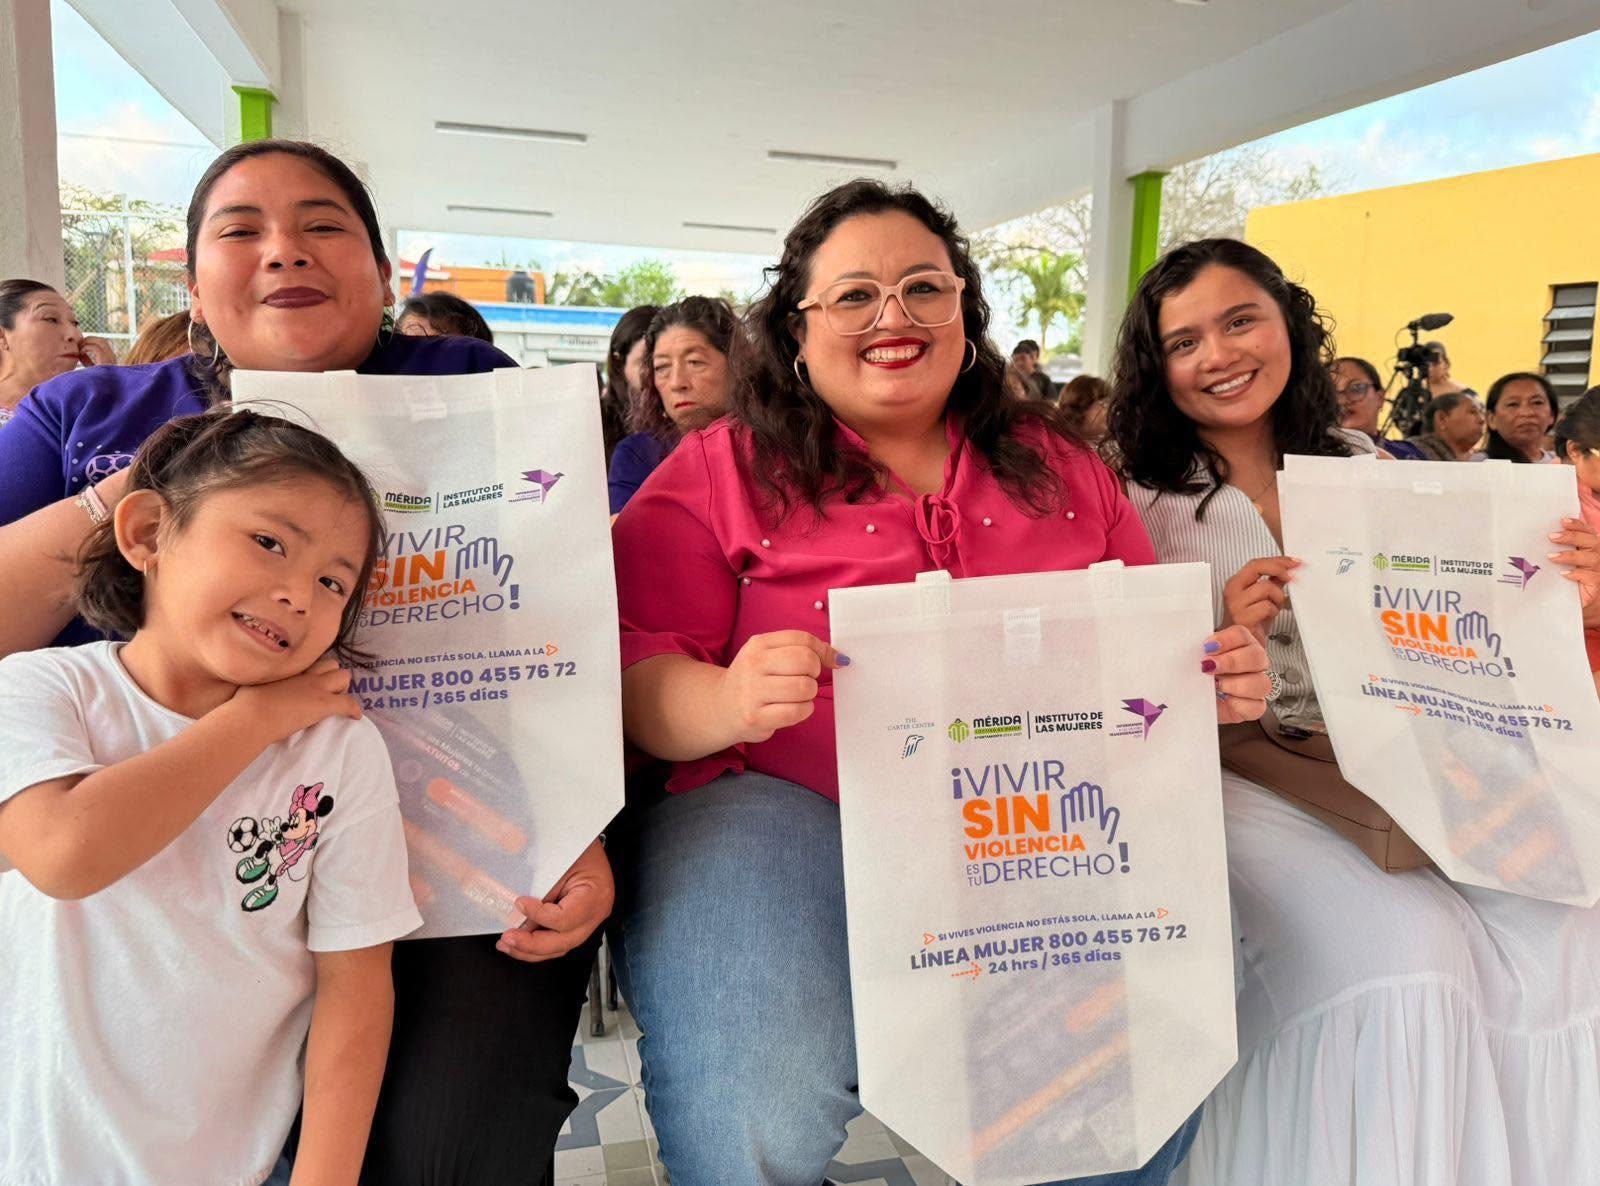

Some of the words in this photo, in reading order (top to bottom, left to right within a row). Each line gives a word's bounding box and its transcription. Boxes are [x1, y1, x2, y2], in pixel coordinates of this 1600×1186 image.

[385, 491, 431, 504] MÉRIDA
[443, 486, 490, 500] INSTITUTO
[492, 483, 504, 491] DE
[443, 499, 460, 509] LAS
[461, 491, 503, 507] MUJERES
[380, 525, 466, 556] VIVIR
[367, 550, 446, 591] SIN
[1440, 559, 1482, 568] INSTITUTO
[1440, 566, 1456, 574] LAS
[1457, 567, 1493, 577] MUJERES
[370, 584, 520, 627] DERECHO!
[1373, 584, 1461, 614] ¡VIVIR
[1380, 610, 1449, 643] SIN
[407, 656, 422, 665] NO
[424, 652, 456, 663] ESTÁS
[488, 649, 522, 659] LLAMA
[524, 648, 531, 656] A
[532, 647, 545, 655] LA
[1387, 635, 1478, 659] VIOLENCIA
[1405, 649, 1516, 678] DERECHO!
[348, 673, 425, 694] MUJER
[431, 669, 474, 688] 800
[479, 666, 521, 684] 455
[525, 664, 549, 680] 76
[553, 661, 577, 677] 72
[363, 696, 385, 710] 24
[389, 696, 418, 708] hrs
[422, 690, 429, 709] /
[433, 690, 466, 705] 365
[469, 688, 509, 702] días
[1361, 682, 1410, 702] LÍNEA
[1410, 692, 1467, 714] MUJER
[1466, 706, 1495, 722] 800
[1498, 714, 1530, 728] 455
[1531, 716, 1552, 729] 76
[1553, 719, 1573, 731] 72
[911, 722, 935, 730] CENTER
[973, 715, 1022, 729] MÉRIDA
[1035, 712, 1088, 724] INSTITUTO
[1090, 711, 1104, 721] DE
[1035, 723, 1055, 733] LAS
[1056, 720, 1103, 732] MUJERES
[1425, 707, 1443, 719] 24
[1444, 711, 1465, 723] hrs
[1472, 718, 1494, 732] 365
[1495, 726, 1523, 739] días
[951, 759, 1066, 800] ¡VIVIR
[962, 793, 1051, 839] SIN
[964, 834, 1086, 861] VIOLENCIA
[966, 864, 980, 876] ES
[983, 842, 1131, 885] DERECHO!
[967, 875, 982, 887] TU
[938, 933, 947, 942] SI
[948, 929, 975, 941] VIVES
[976, 921, 1025, 936] VIOLENCIA
[1026, 919, 1041, 928] NO
[1041, 915, 1071, 926] ESTÁS
[1071, 914, 1100, 924] SOLA,
[1101, 912, 1134, 922] LLAMA
[1135, 911, 1143, 920] A
[1143, 911, 1156, 919] LA
[910, 948, 971, 970] LÍNEA
[974, 936, 1045, 960] MUJER
[1048, 931, 1088, 950] 800
[1092, 928, 1134, 945] 455
[1137, 927, 1161, 943] 76
[1164, 924, 1188, 940] 72
[988, 962, 1009, 975] 24
[1011, 957, 1039, 972] hrs
[1041, 953, 1049, 970] /
[1051, 952, 1082, 967] 365
[1084, 947, 1122, 963] días
